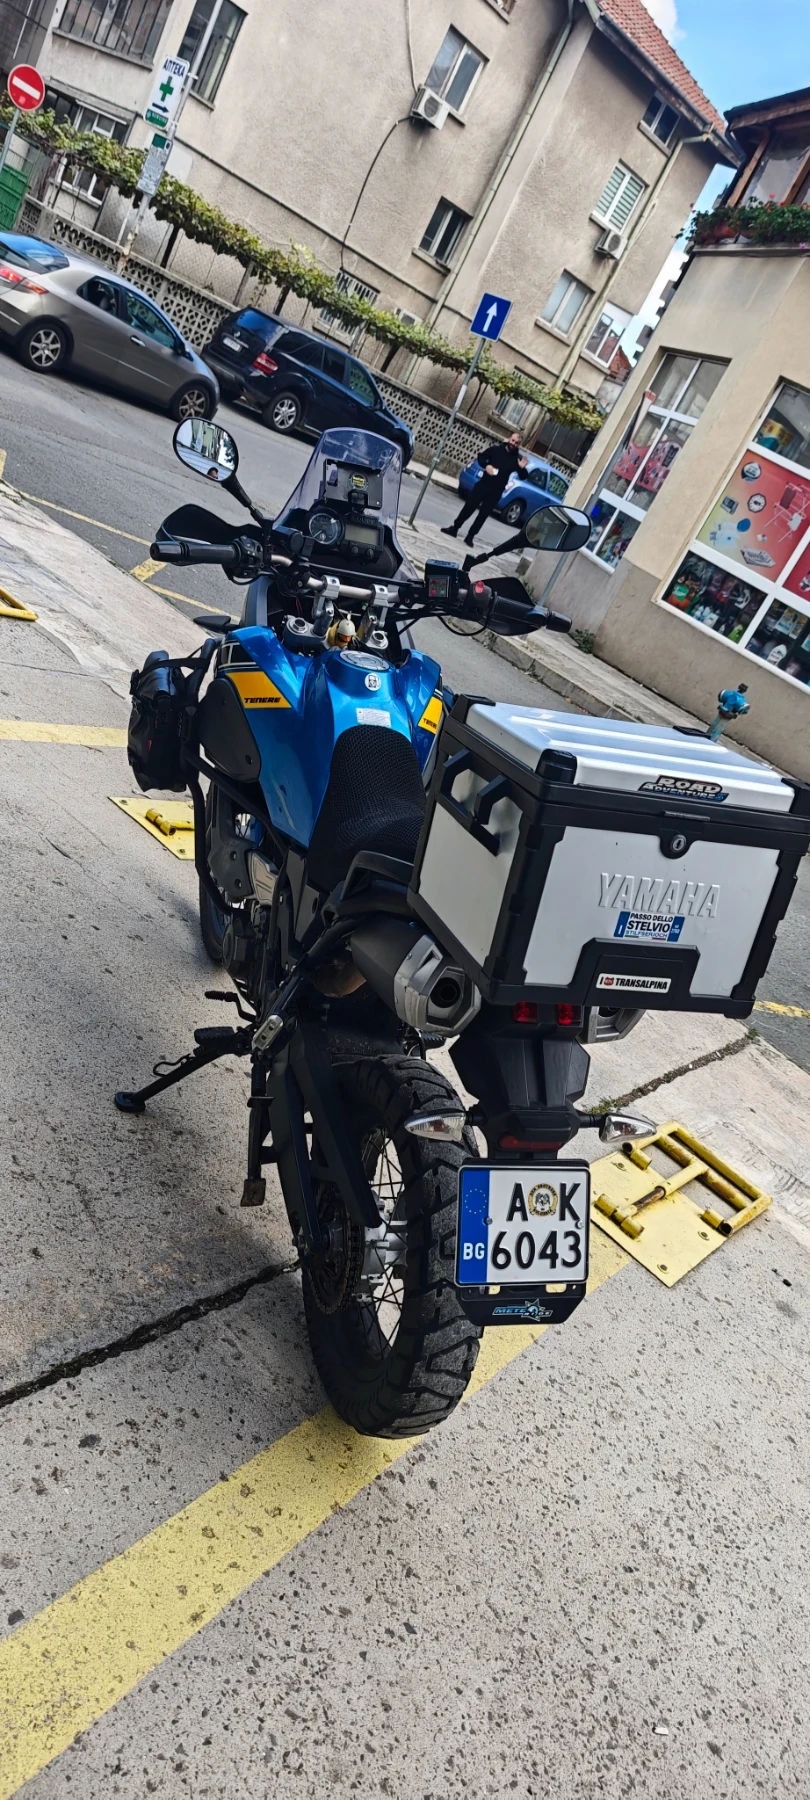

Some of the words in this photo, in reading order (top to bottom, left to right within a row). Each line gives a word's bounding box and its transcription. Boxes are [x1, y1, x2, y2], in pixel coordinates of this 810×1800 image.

[163, 58, 186, 77] АПТЕКА
[657, 777, 722, 794] ROAD
[598, 873, 720, 918] YAMAHA
[627, 920, 671, 933] STELVIO
[630, 913, 652, 921] PASSO
[652, 915, 674, 923] DELLO
[615, 978, 669, 990] TRANSALPINA
[506, 1182, 529, 1222] A
[559, 1182, 581, 1222] K
[463, 1242, 485, 1260] BG
[491, 1230, 582, 1270] 6043
